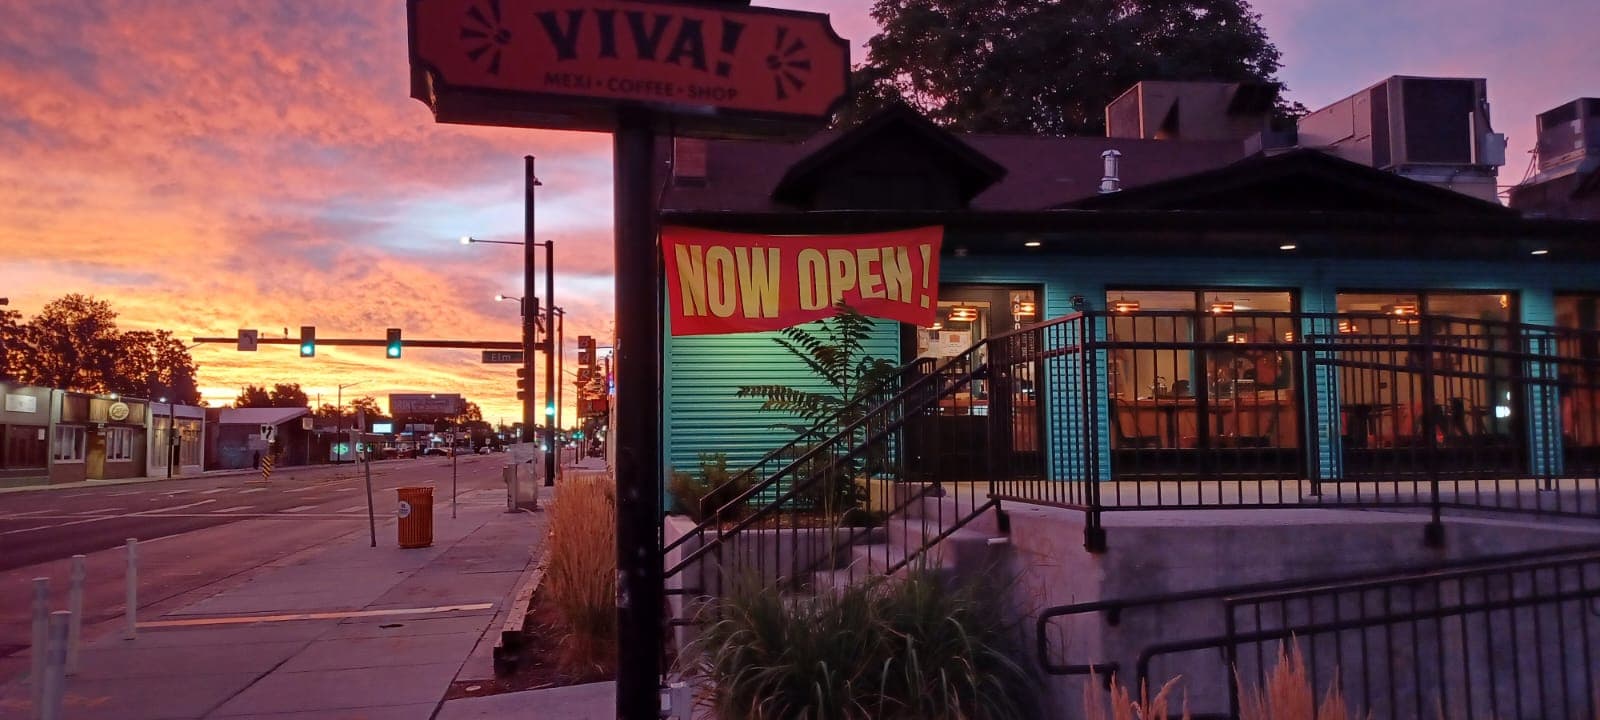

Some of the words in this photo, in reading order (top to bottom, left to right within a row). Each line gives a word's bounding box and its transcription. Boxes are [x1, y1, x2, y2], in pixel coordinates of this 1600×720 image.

[535, 8, 748, 78] VIVA!
[544, 71, 592, 89] MEXI
[607, 77, 674, 97] COFFEE
[688, 84, 738, 101] SHOP
[675, 243, 781, 319] NOW
[491, 353, 511, 361] Elm
